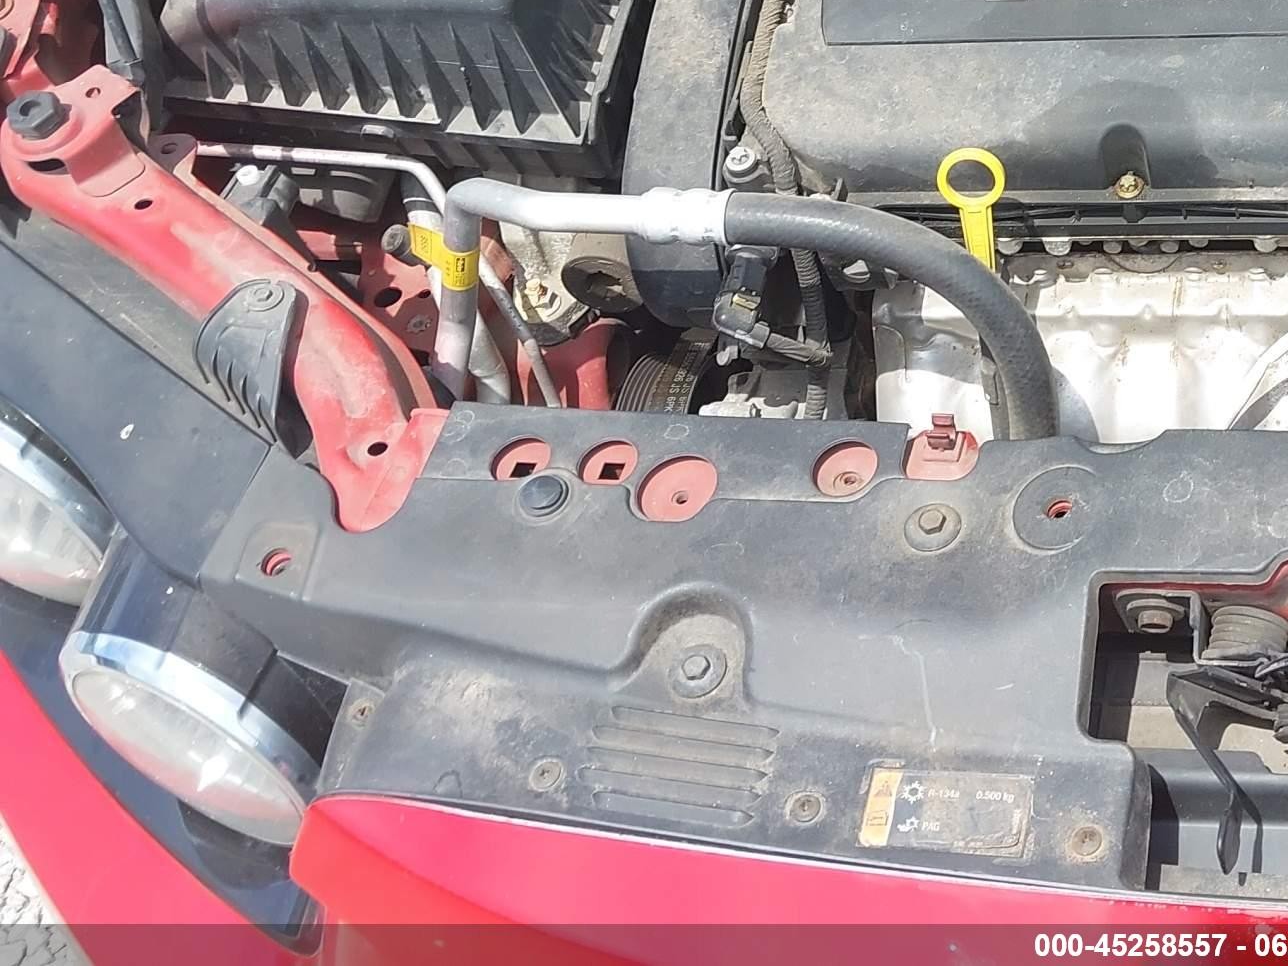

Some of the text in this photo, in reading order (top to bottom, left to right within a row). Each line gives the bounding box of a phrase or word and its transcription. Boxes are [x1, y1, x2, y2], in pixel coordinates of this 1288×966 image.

[927, 787, 1015, 803] R-134a 0.500 kg
[921, 820, 940, 832] PAG
